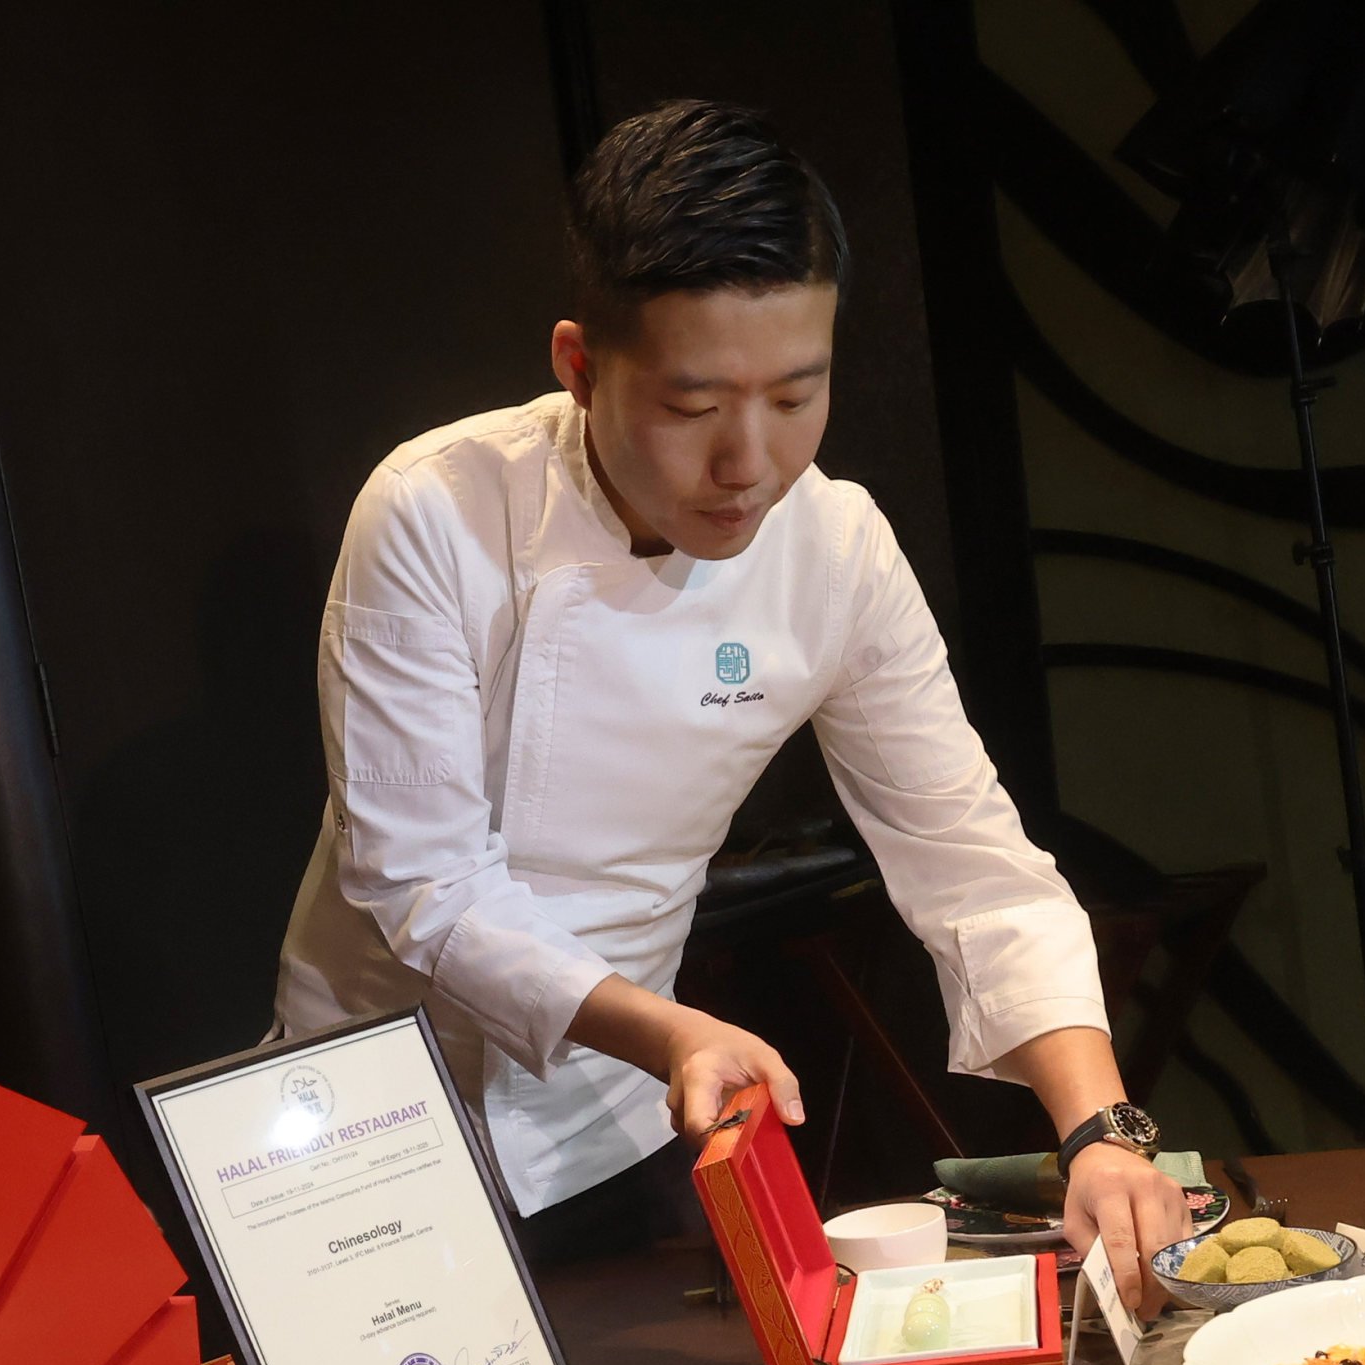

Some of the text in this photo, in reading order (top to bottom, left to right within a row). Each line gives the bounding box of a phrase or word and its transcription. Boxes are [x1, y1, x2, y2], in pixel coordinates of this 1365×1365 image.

[700, 691, 764, 707] Chef Saito
[216, 1100, 429, 1182] HALAL FRIENDLY RESTAURANT
[327, 1219, 403, 1254] Chinesology
[371, 1299, 421, 1325] Halal Menu
